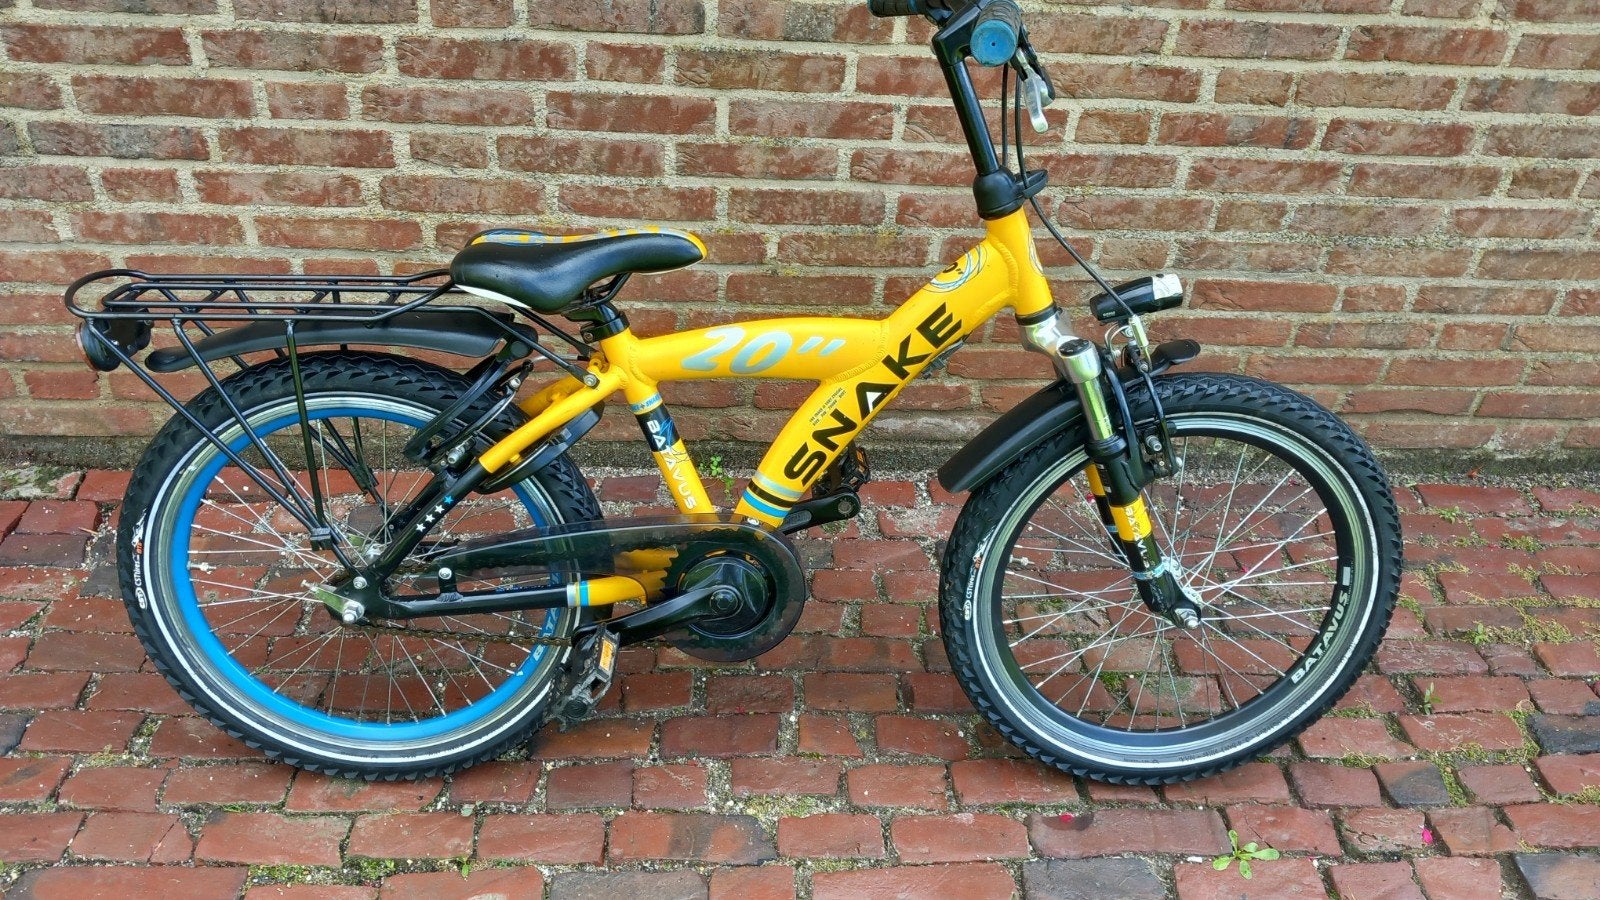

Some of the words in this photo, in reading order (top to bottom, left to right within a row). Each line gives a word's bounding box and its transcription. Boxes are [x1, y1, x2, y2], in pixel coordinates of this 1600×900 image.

[784, 302, 963, 486] SNAKE
[646, 419, 697, 509] BATAVUS
[1291, 590, 1348, 684] BATAVUS
